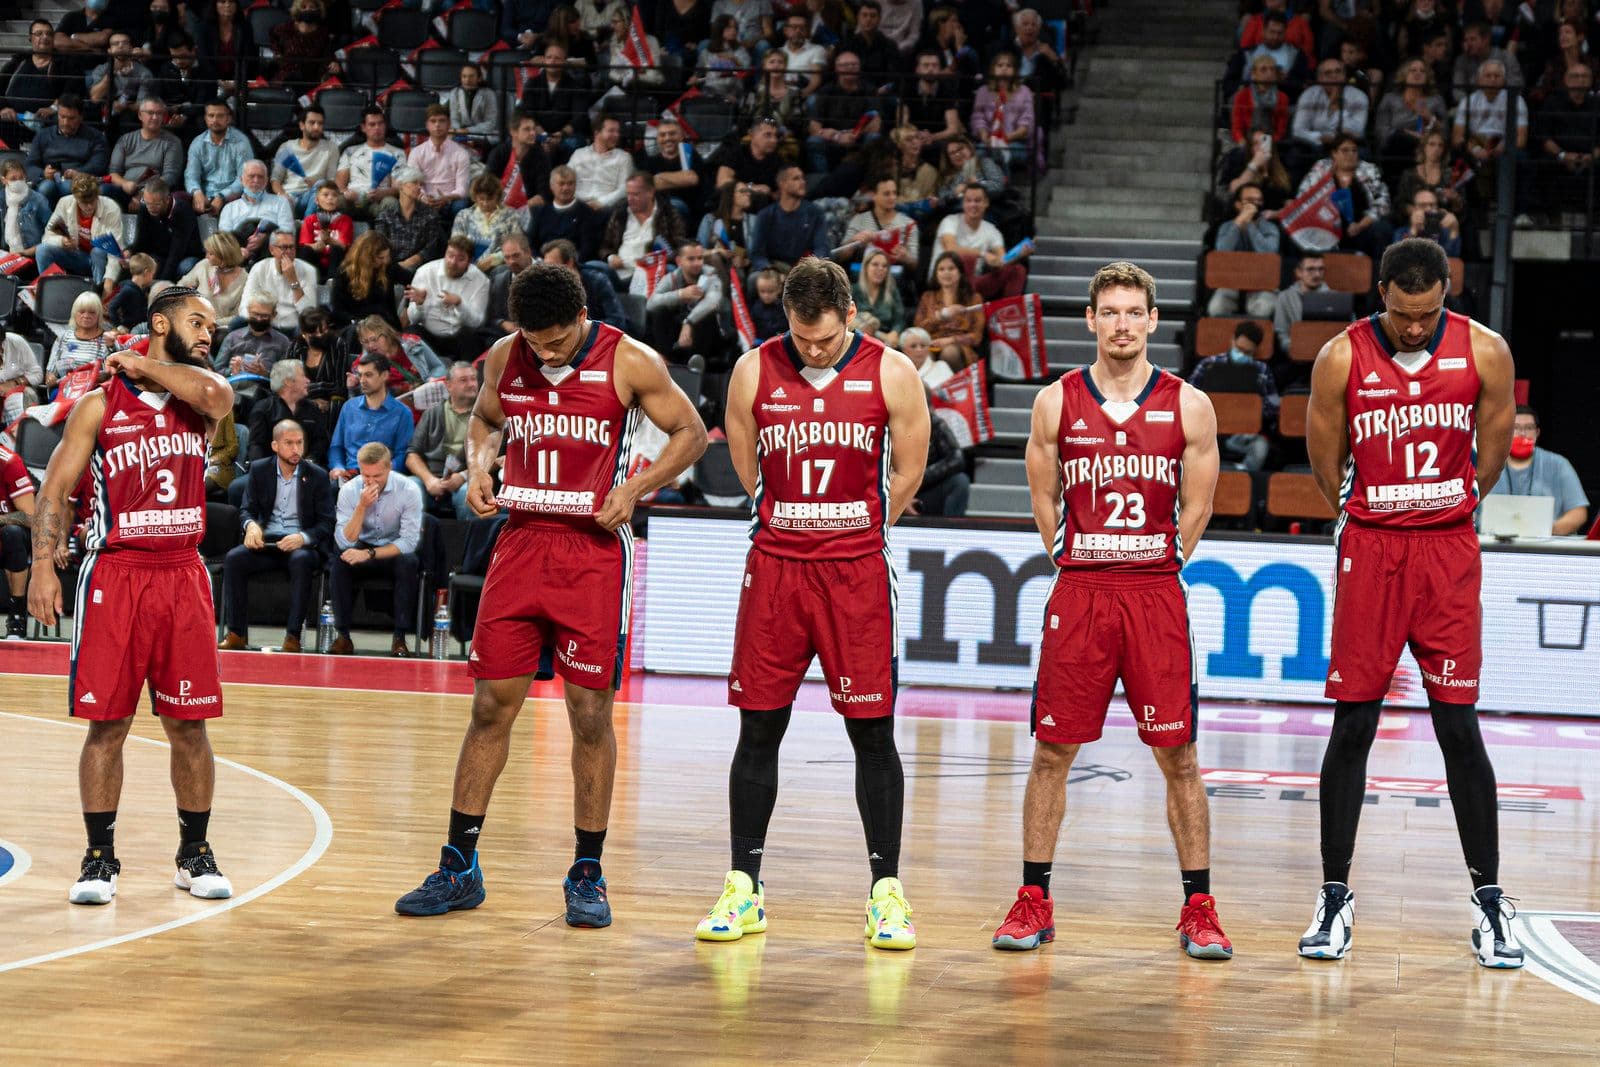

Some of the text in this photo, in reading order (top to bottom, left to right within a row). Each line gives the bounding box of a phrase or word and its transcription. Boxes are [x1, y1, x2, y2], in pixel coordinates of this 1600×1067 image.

[760, 419, 876, 480] STRASBOURG
[1405, 440, 1440, 479] 12
[106, 432, 204, 491] STRASBOUR
[538, 449, 558, 485] 11
[156, 469, 177, 504] 3
[802, 458, 836, 496] 17
[1063, 452, 1176, 512] STRASBOURG
[496, 484, 595, 505] LIEBHERR
[1367, 478, 1466, 503] LIEBHERR
[516, 501, 593, 513] ELECTROMENAGER
[772, 501, 870, 519] LIEBHERR
[1103, 492, 1147, 529] 23
[119, 527, 145, 537] FROID
[769, 516, 871, 529] FROID ELECTROMENAGER
[1072, 532, 1168, 551] LIEBHERR
[1071, 549, 1092, 559] FROID
[155, 690, 218, 706] PIERRE LANNIER
[843, 693, 883, 703] LANNIER
[1147, 720, 1185, 732] LANNIER
